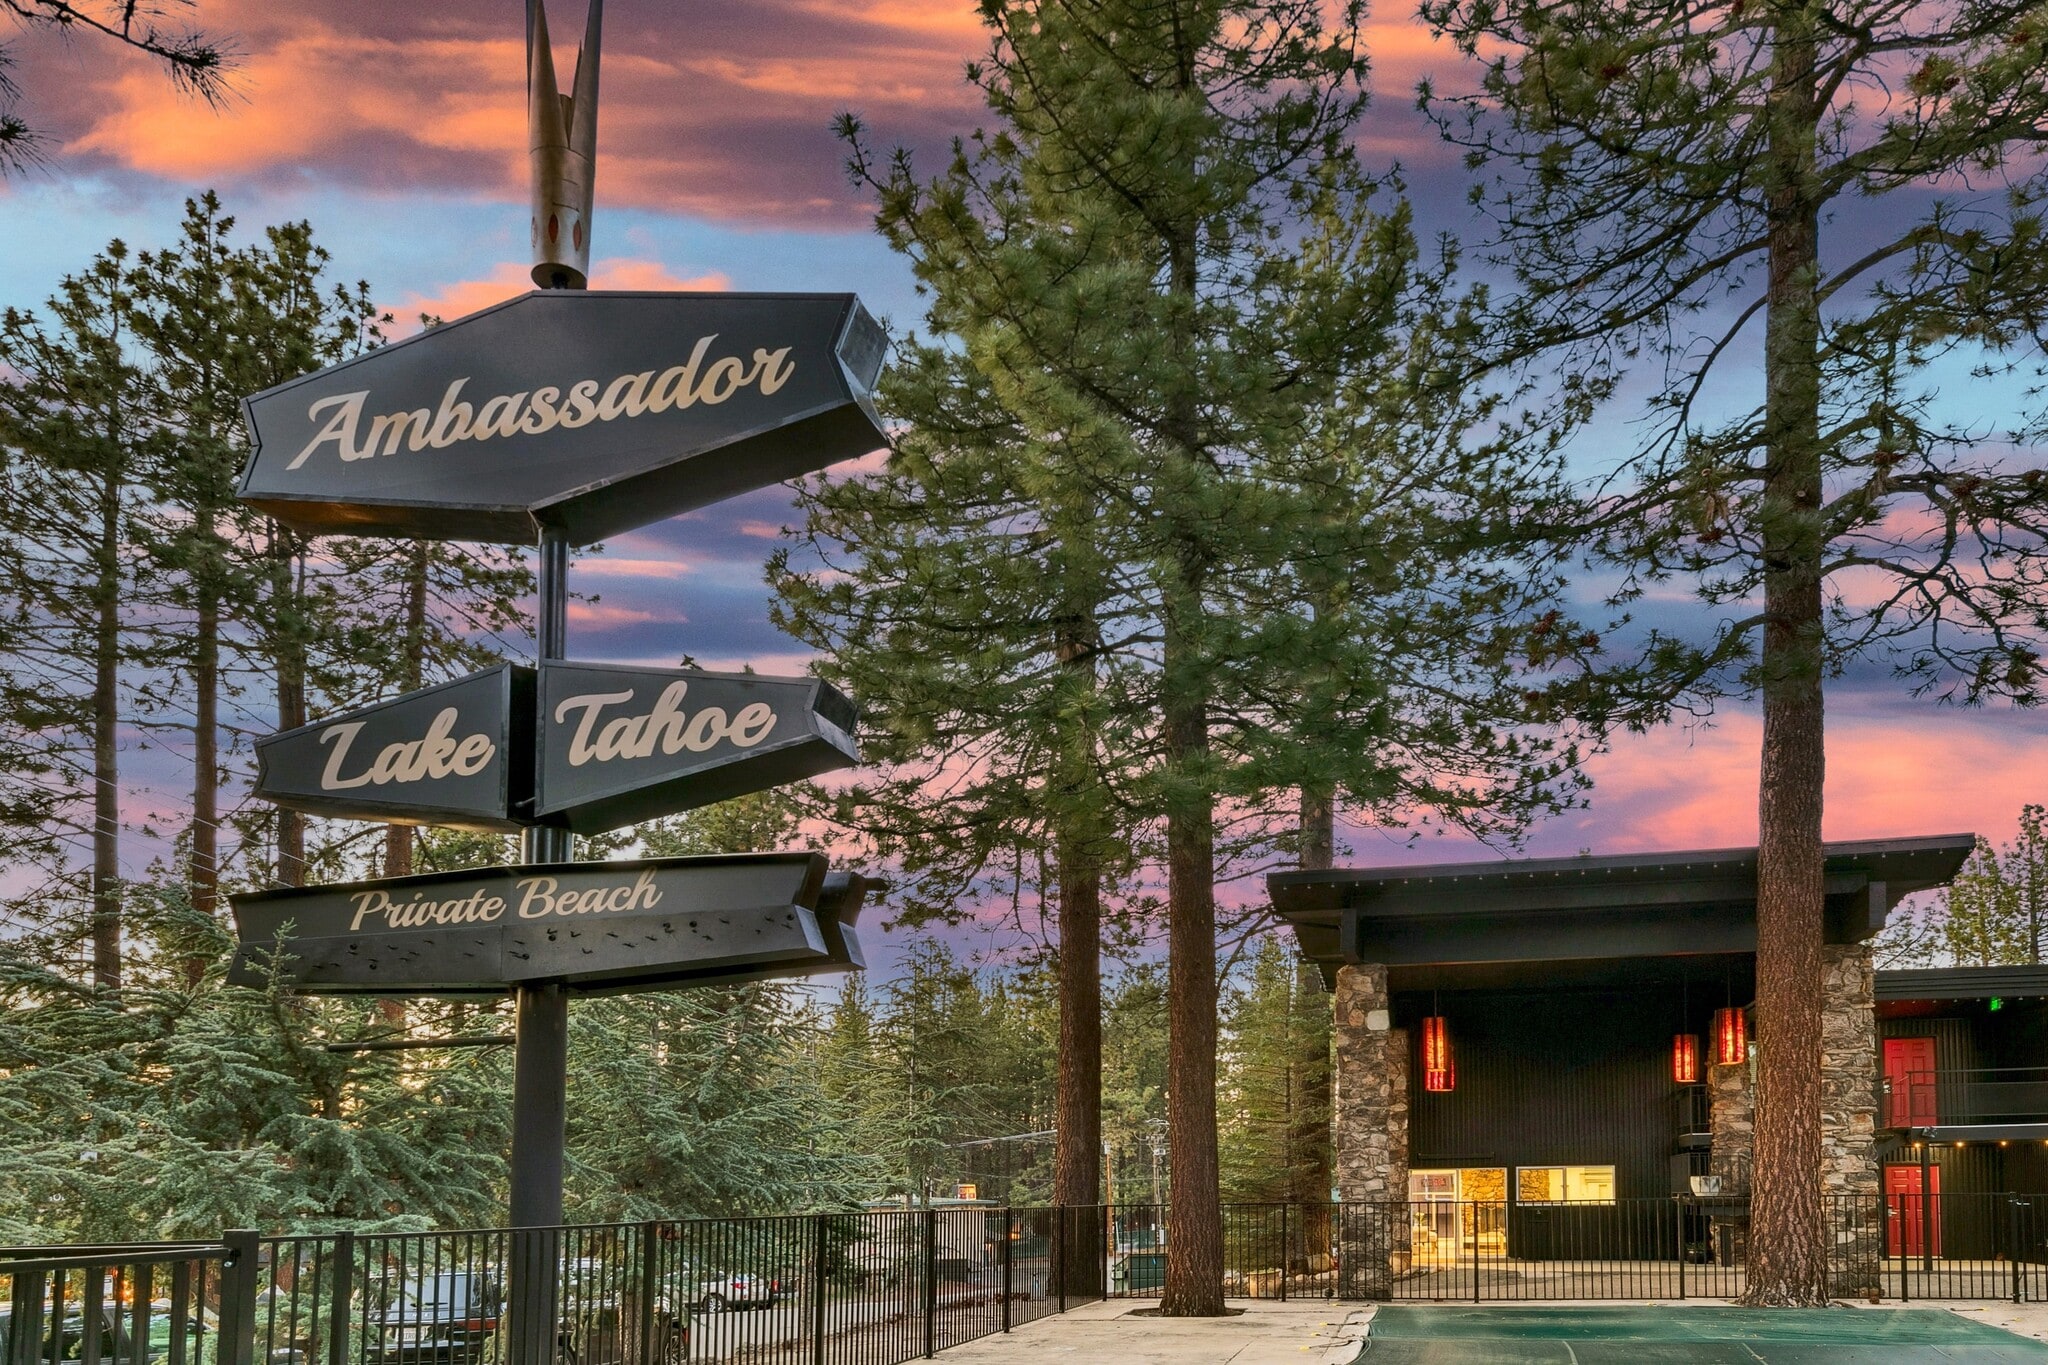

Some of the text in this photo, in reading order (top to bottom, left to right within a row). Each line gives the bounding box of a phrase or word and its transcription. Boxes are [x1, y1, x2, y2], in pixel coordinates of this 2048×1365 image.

[286, 333, 795, 470] Ambassador
[320, 680, 778, 790] Lake Tahoe
[350, 867, 664, 931] Private Beach
